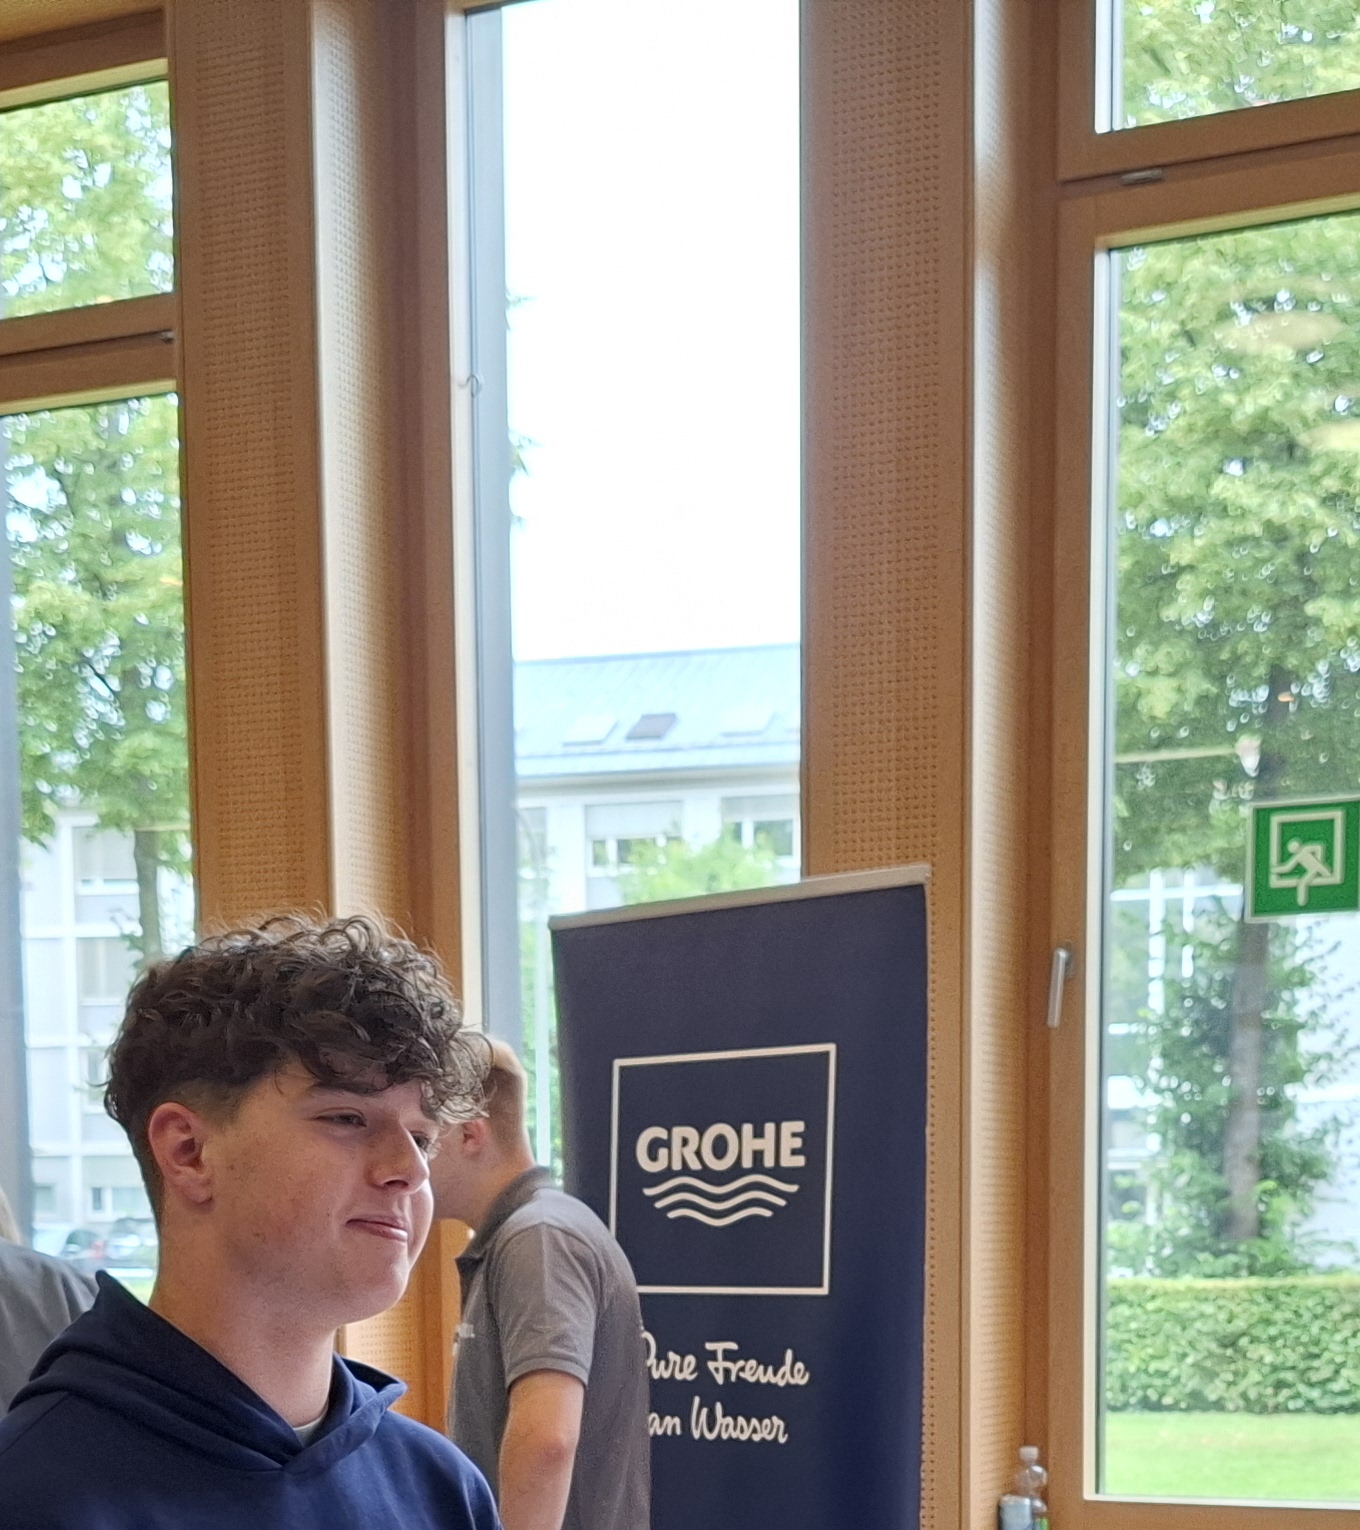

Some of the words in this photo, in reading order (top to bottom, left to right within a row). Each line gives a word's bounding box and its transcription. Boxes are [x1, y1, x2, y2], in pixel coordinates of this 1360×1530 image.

[636, 1121, 806, 1173] GROHE
[704, 1341, 810, 1387] Freude
[647, 1412, 682, 1438] an
[691, 1395, 789, 1444] Wasser
